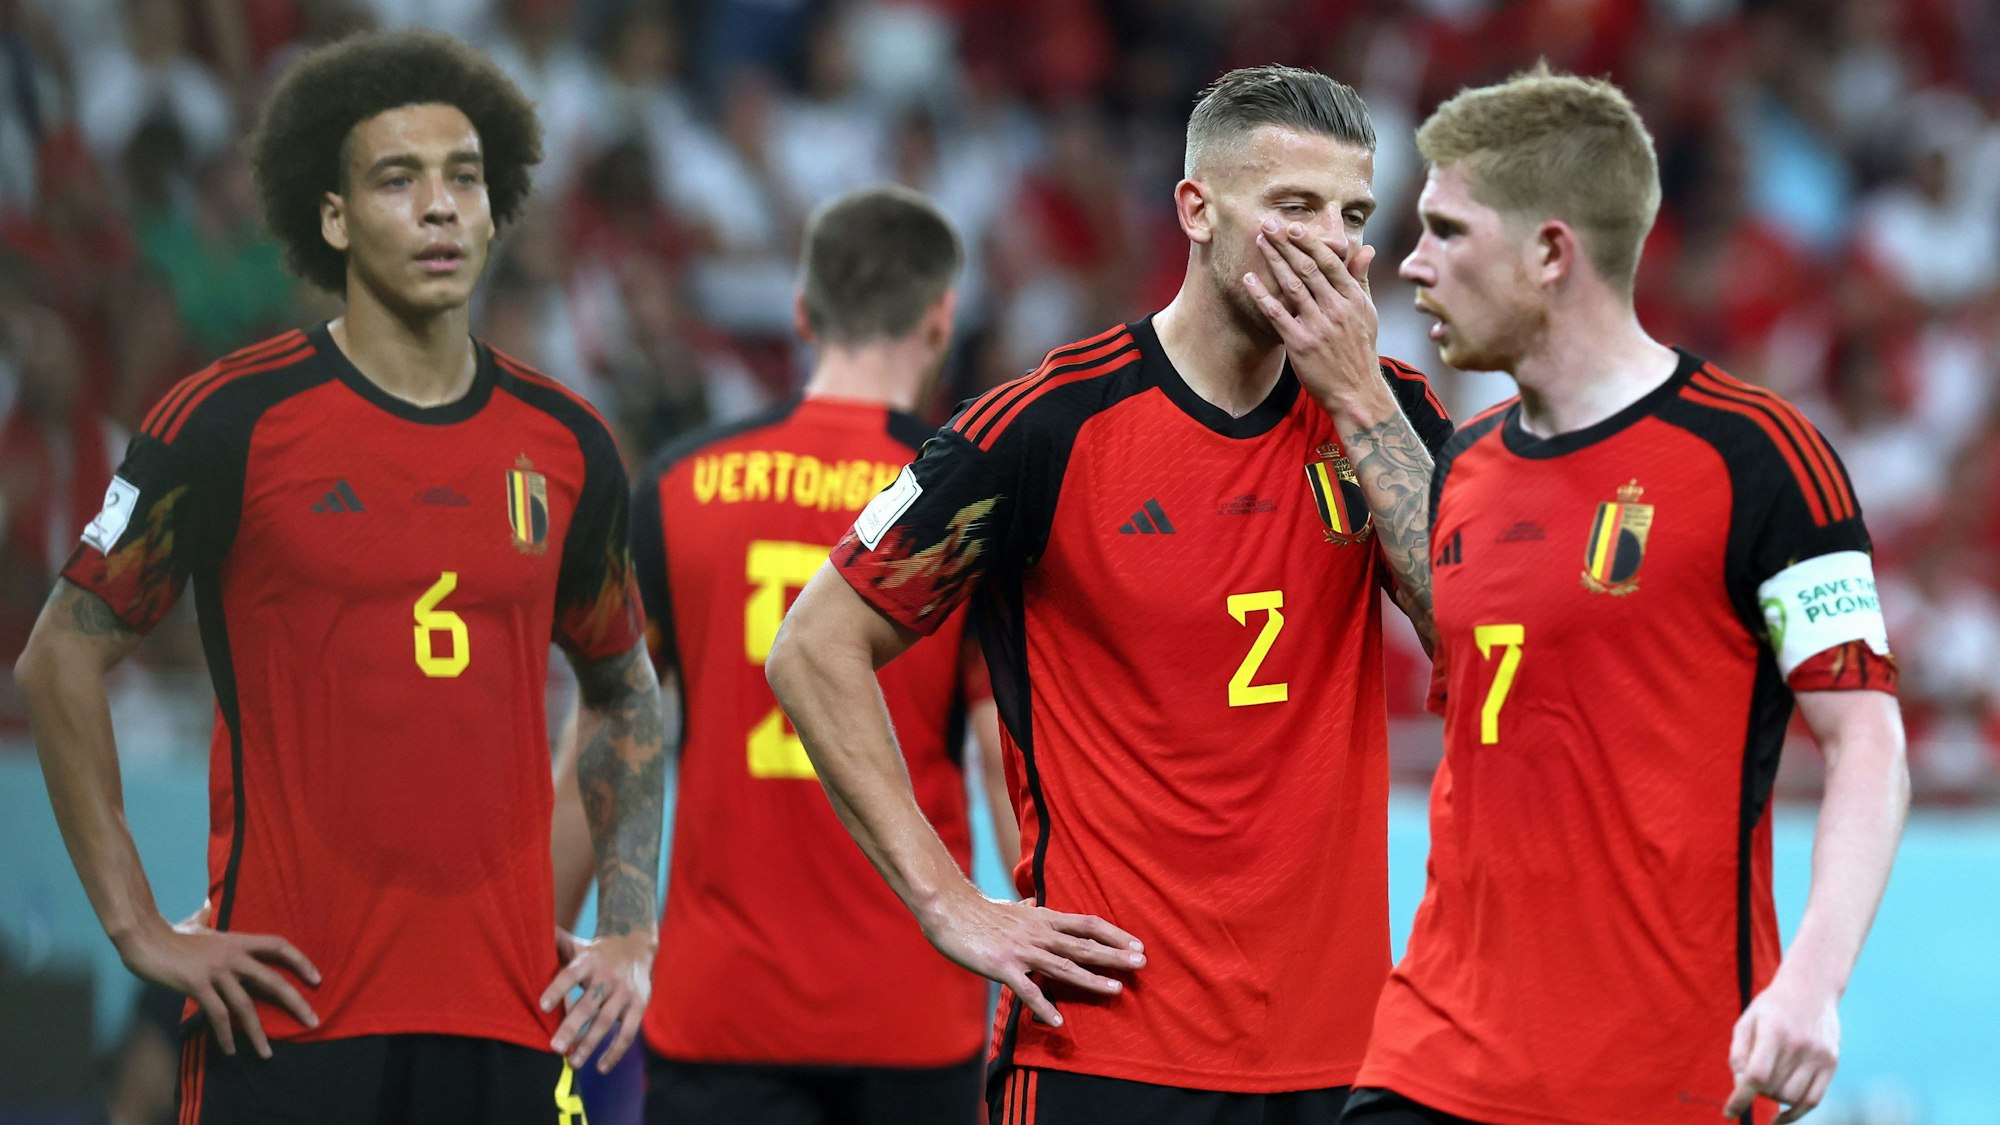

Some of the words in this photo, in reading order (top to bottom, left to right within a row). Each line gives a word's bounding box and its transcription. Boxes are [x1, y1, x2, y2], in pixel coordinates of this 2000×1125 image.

[413, 570, 470, 678] 6
[1797, 577, 1850, 606] SAVE
[1226, 589, 1289, 708] 2
[1473, 623, 1525, 745] 7
